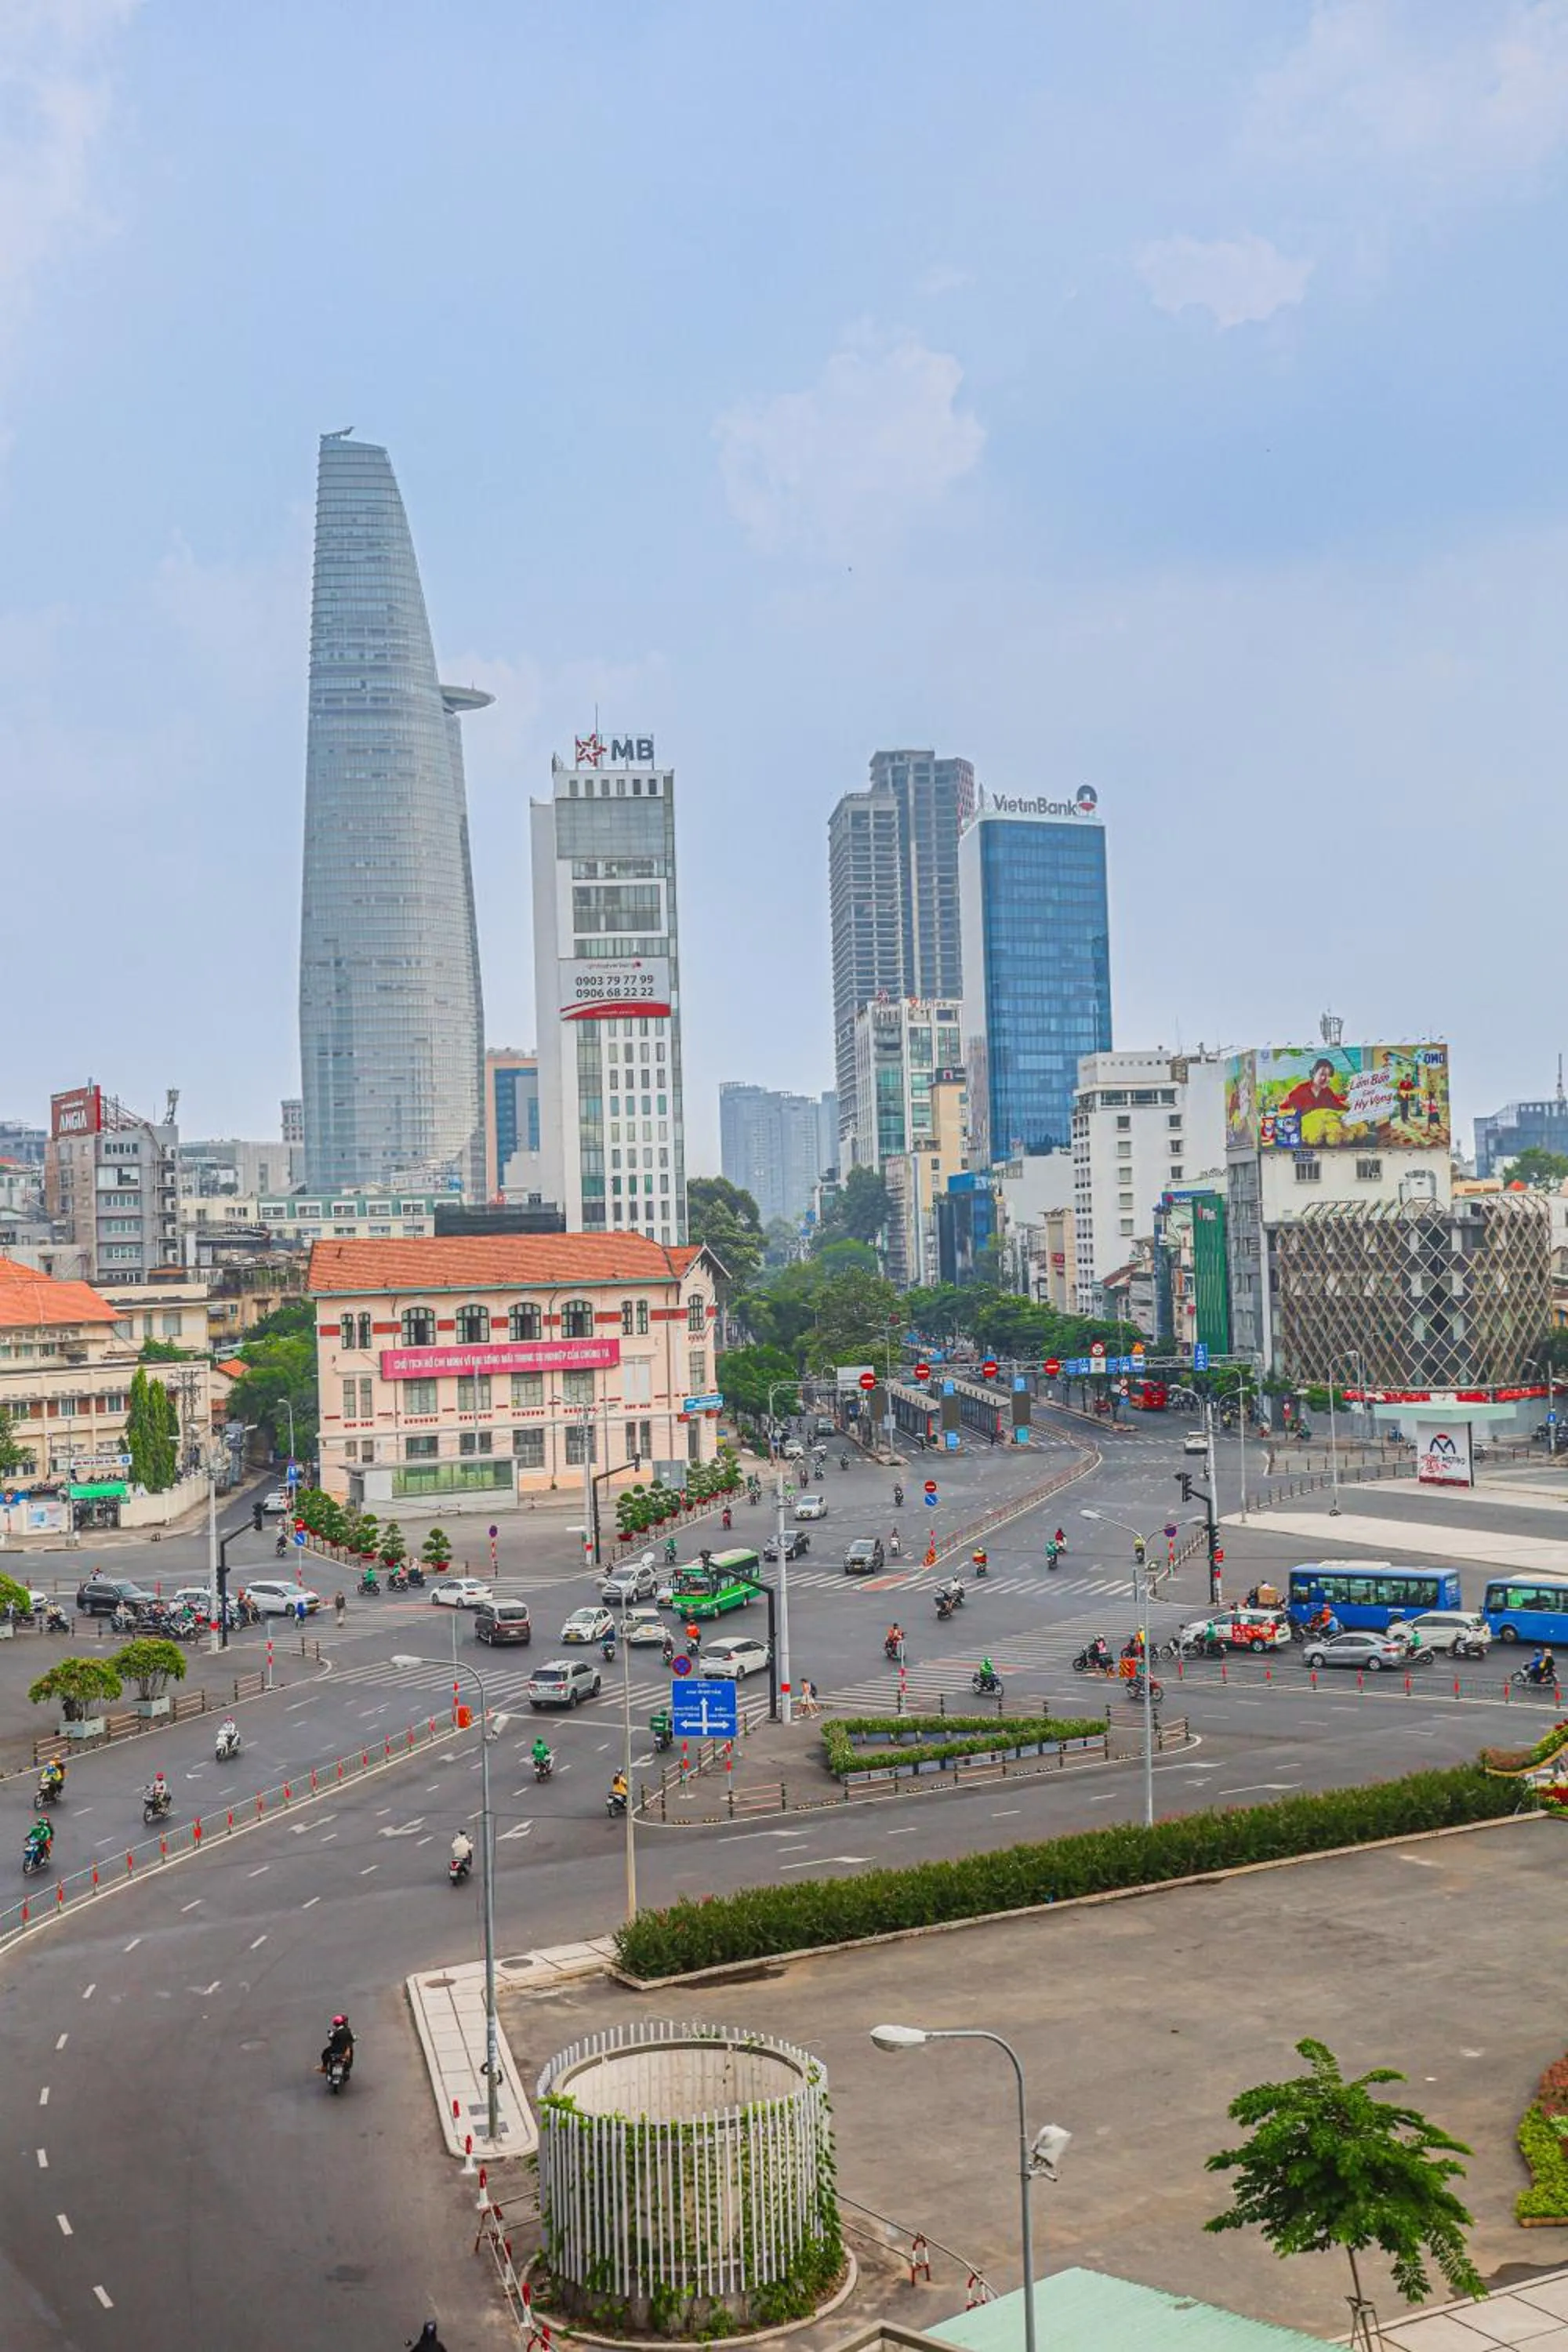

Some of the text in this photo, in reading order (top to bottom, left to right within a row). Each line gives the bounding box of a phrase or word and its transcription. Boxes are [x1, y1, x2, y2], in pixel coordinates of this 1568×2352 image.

[612, 739, 654, 761] MB
[993, 793, 1078, 816] VietinBank
[575, 975, 654, 985] 0903 79 77 99
[576, 986, 655, 998] 0906 68 22 22
[1424, 1053, 1445, 1064] OMO
